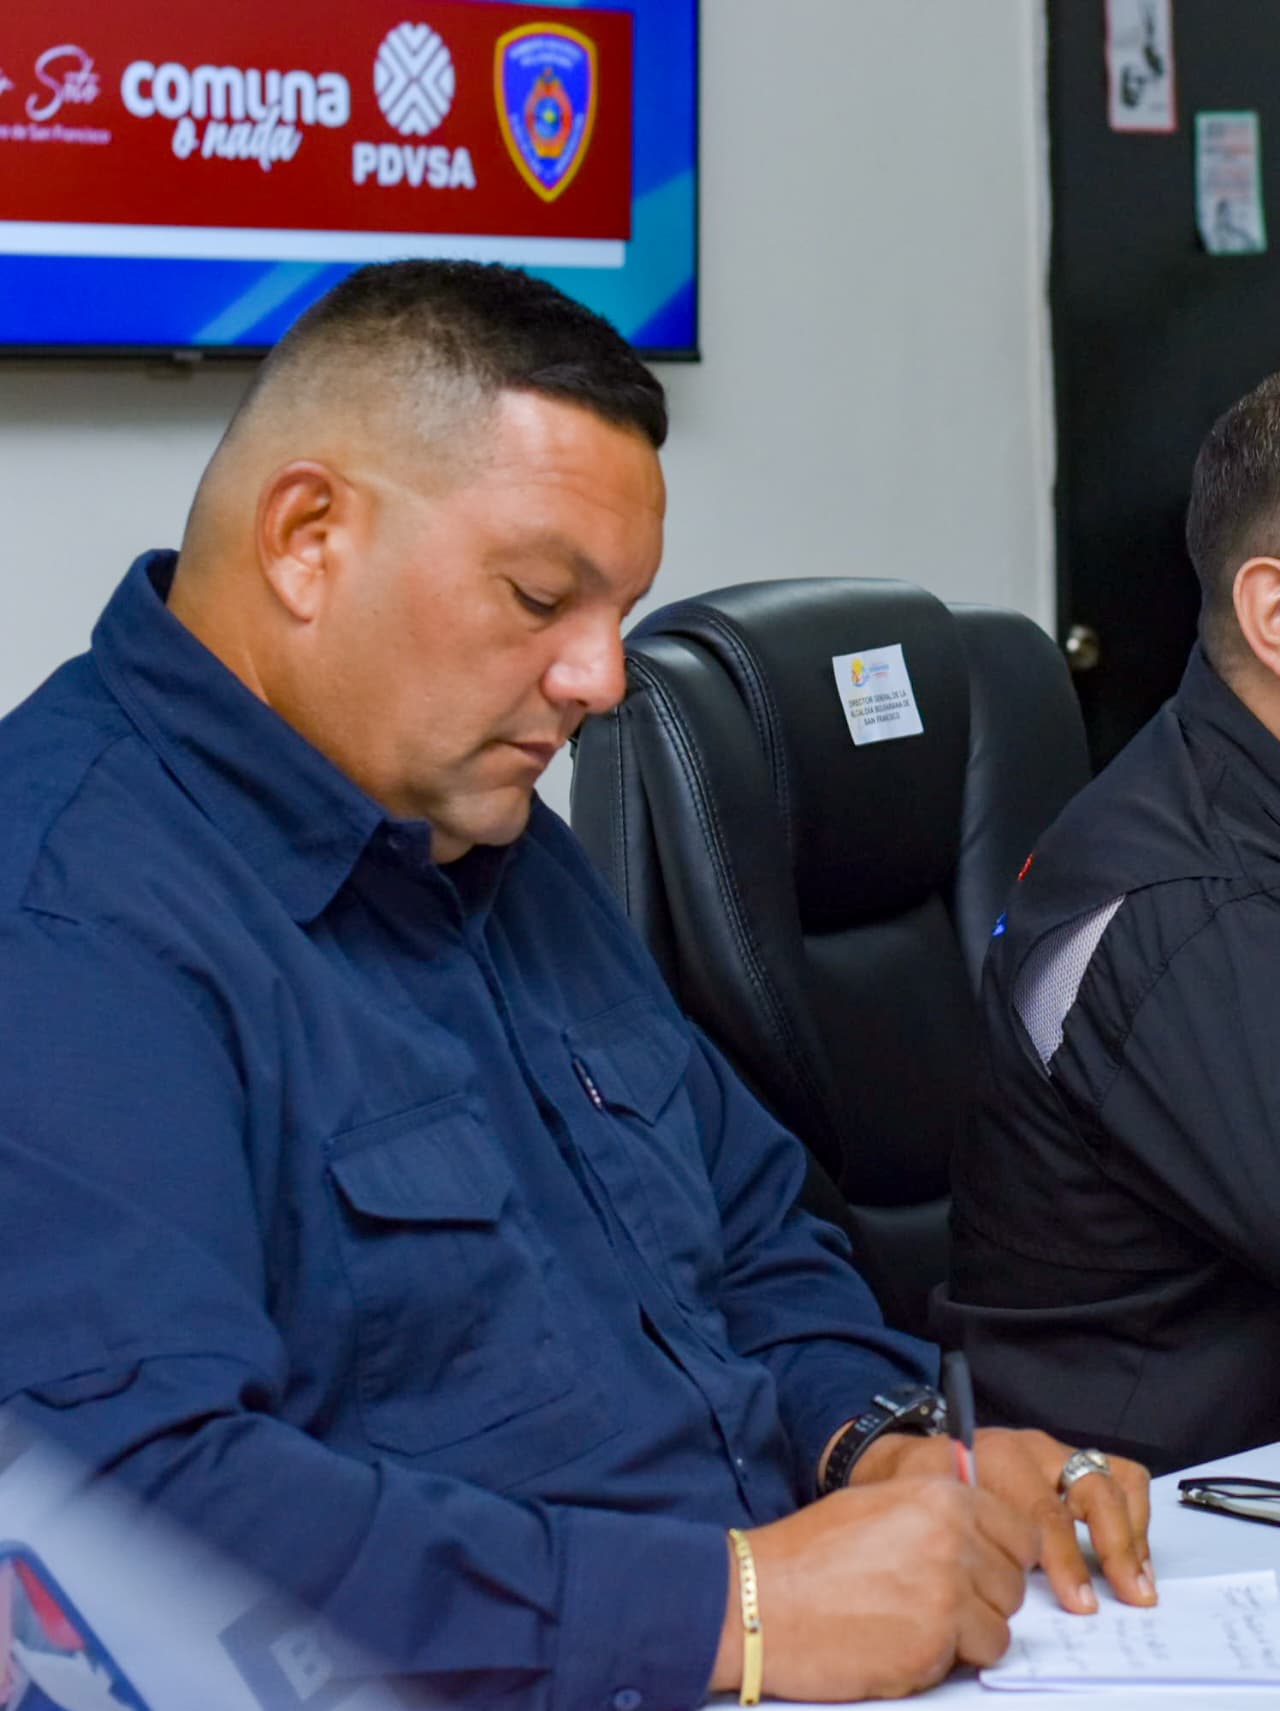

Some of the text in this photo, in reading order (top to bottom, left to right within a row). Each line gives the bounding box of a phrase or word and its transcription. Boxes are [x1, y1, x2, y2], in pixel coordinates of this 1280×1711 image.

[121, 61, 351, 128] comuna
[201, 101, 303, 171] nada
[353, 142, 477, 190] PDVSA
